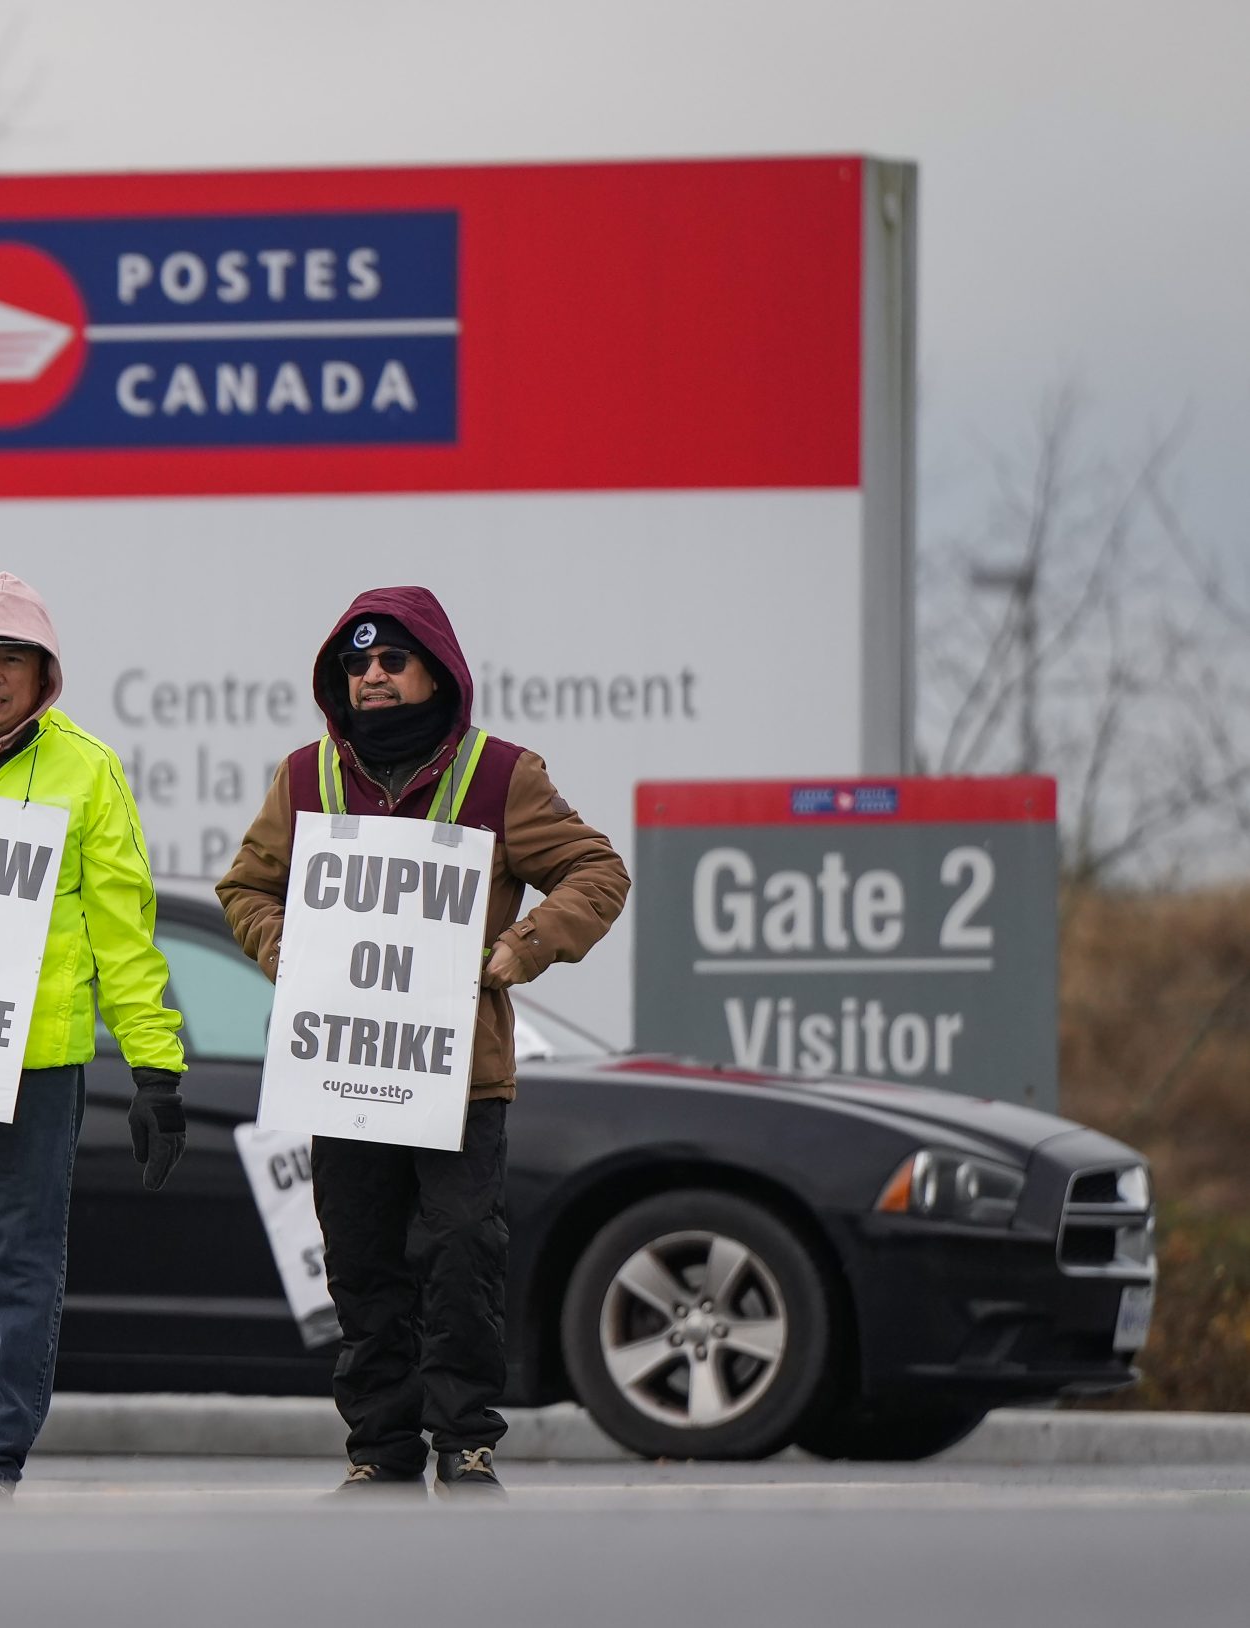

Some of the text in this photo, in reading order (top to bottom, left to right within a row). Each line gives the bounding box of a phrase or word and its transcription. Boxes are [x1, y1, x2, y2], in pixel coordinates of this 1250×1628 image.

[116, 249, 382, 304] POSTES
[116, 361, 417, 416] CANADA
[113, 668, 295, 727] Centre
[480, 660, 697, 722] itement
[197, 745, 243, 804] la
[303, 852, 481, 925] CUPW
[692, 845, 996, 952] Gate 2
[349, 940, 414, 993] ON
[290, 1011, 455, 1076] STRIKE
[723, 996, 963, 1076] Visitor
[268, 1146, 312, 1191] CU
